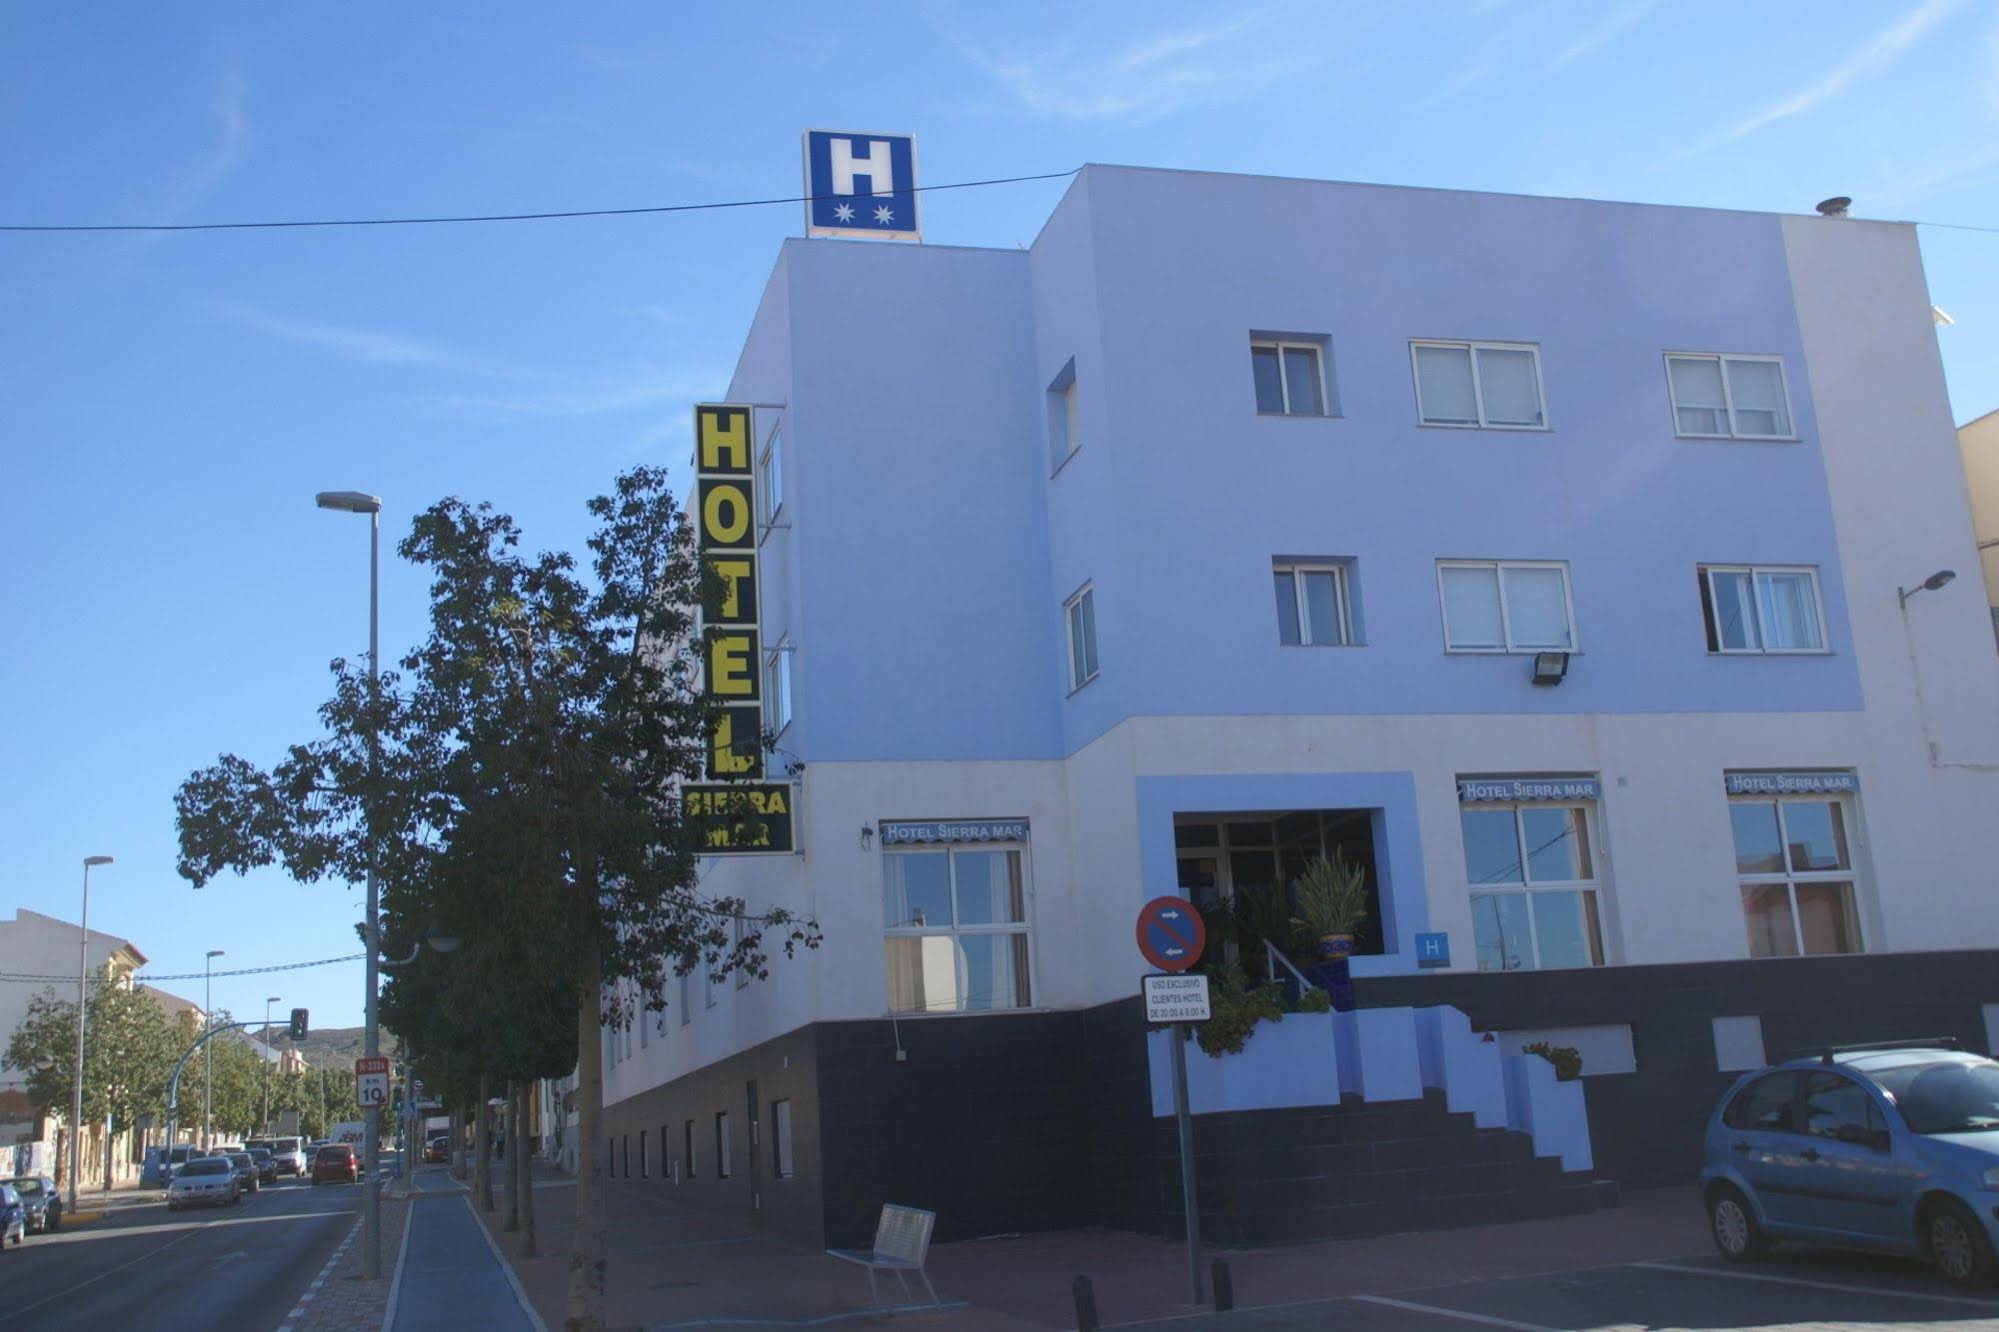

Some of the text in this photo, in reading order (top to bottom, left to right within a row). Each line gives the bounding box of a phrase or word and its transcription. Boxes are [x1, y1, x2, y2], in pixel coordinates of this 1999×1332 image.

[830, 138, 894, 198] H
[702, 412, 753, 773] HOTEL
[1734, 775, 1774, 789] HOTEL
[1776, 774, 1820, 788] SIERRA
[1466, 782, 1594, 797] HOTEL SIERRA MAR
[888, 823, 1022, 838] HOTEL SIERRA MAR
[1426, 939, 1439, 956] H
[363, 1088, 381, 1102] 10
